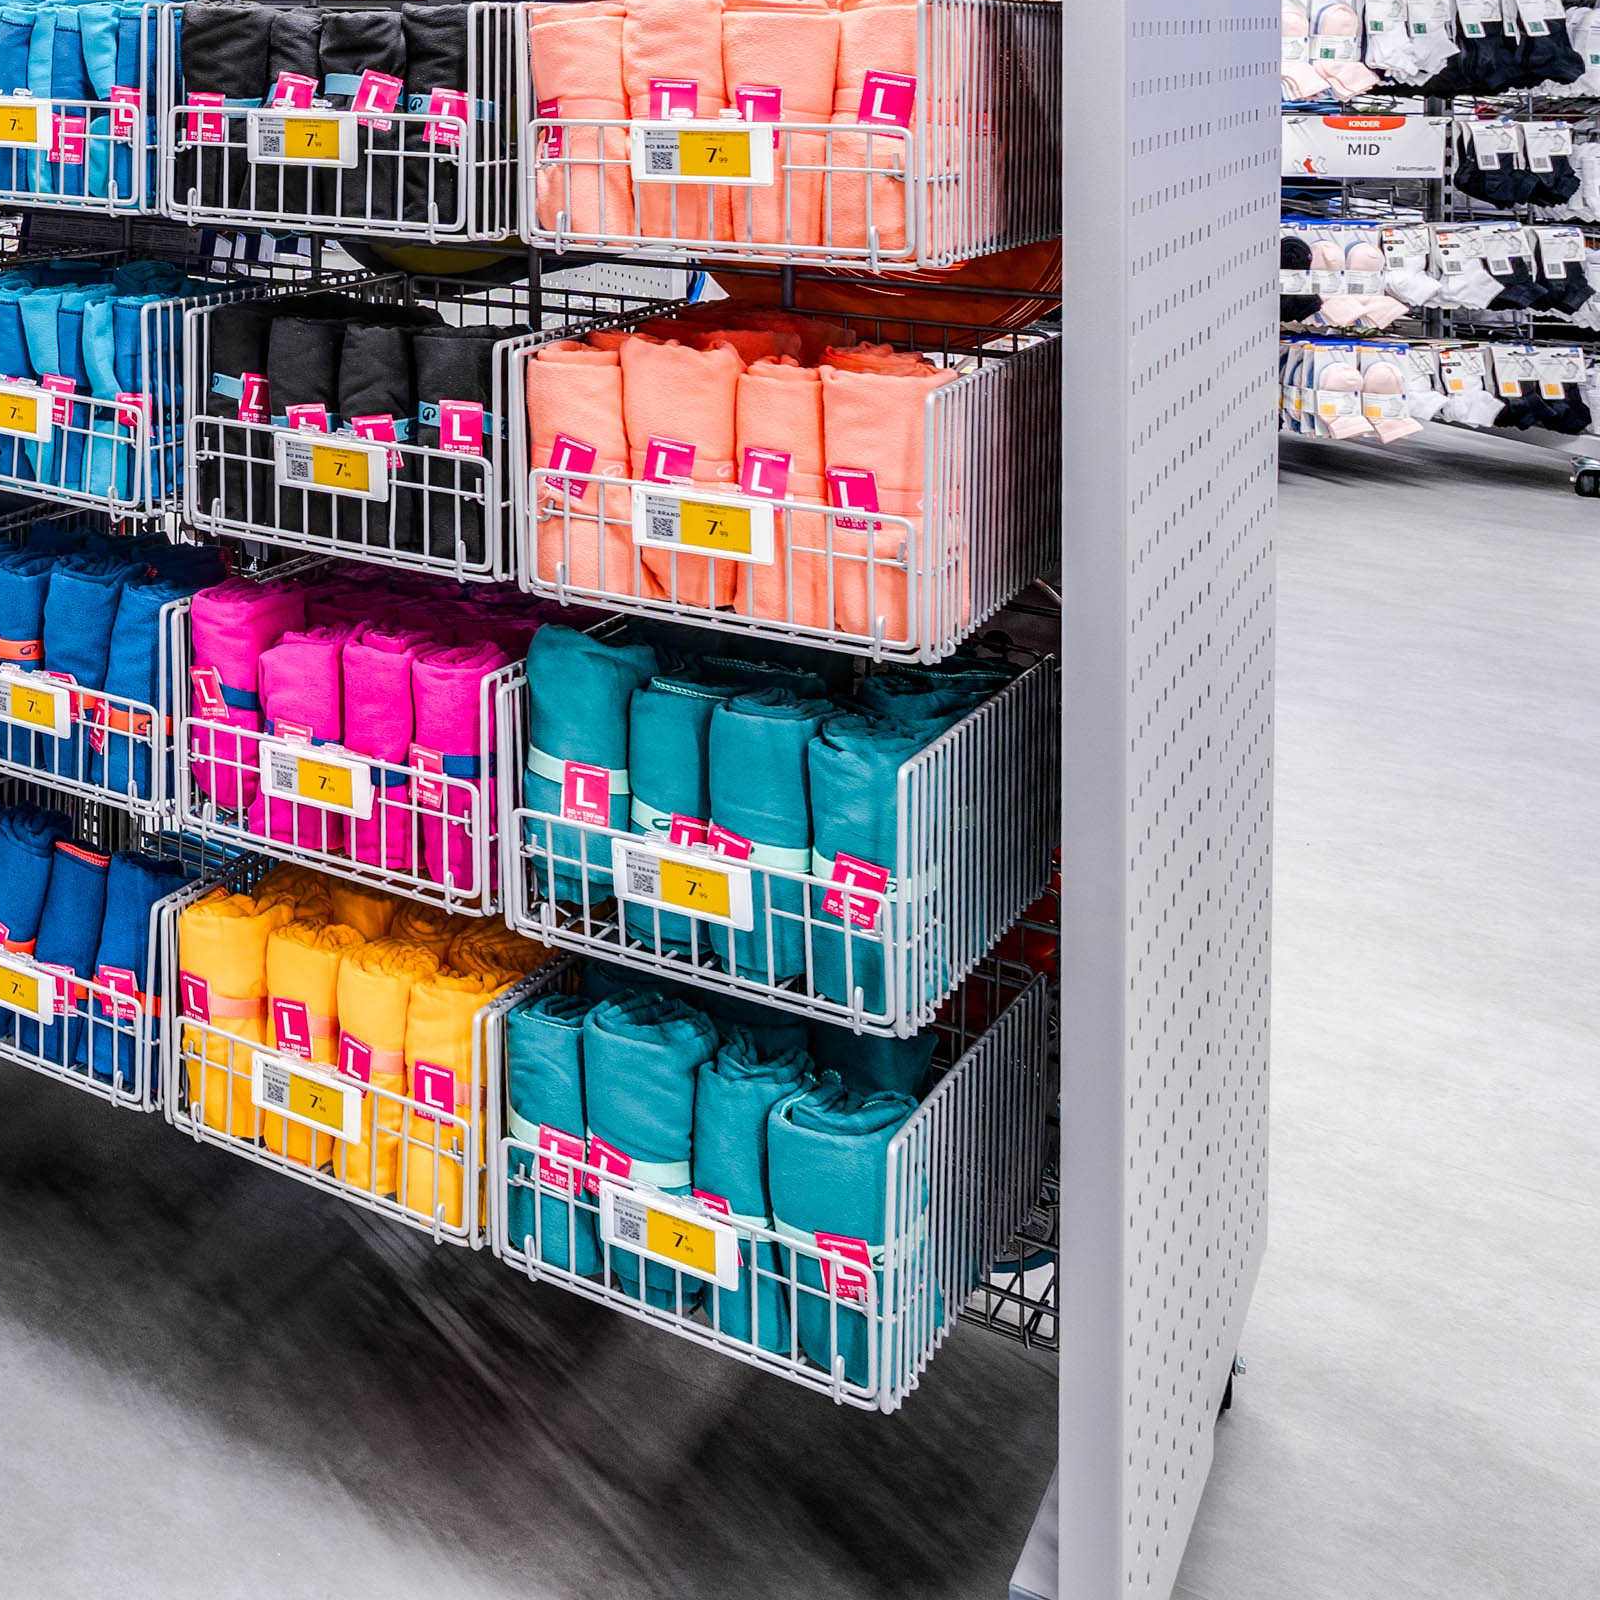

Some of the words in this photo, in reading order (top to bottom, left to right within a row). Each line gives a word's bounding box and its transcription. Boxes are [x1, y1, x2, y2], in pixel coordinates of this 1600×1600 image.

[365, 85, 384, 114] L
[871, 87, 897, 121] L
[1348, 120, 1381, 128] KINDER
[305, 133, 314, 147] 7
[1347, 143, 1381, 156] MID
[705, 147, 717, 163] 7
[249, 385, 263, 410] L
[452, 413, 473, 442] L
[333, 462, 342, 476] 7
[654, 451, 681, 481] L
[750, 461, 774, 494] L
[837, 480, 866, 512] L
[658, 511, 681, 519] BRAND
[706, 519, 718, 535] 7
[199, 678, 218, 704] L
[318, 775, 327, 790] 7
[575, 776, 597, 809] L
[686, 879, 697, 896] 7
[188, 984, 204, 1014] L
[282, 1011, 302, 1042] L
[346, 1047, 362, 1079] L
[309, 1094, 318, 1108] 7
[424, 1075, 445, 1108] L
[672, 1231, 683, 1248] 7
